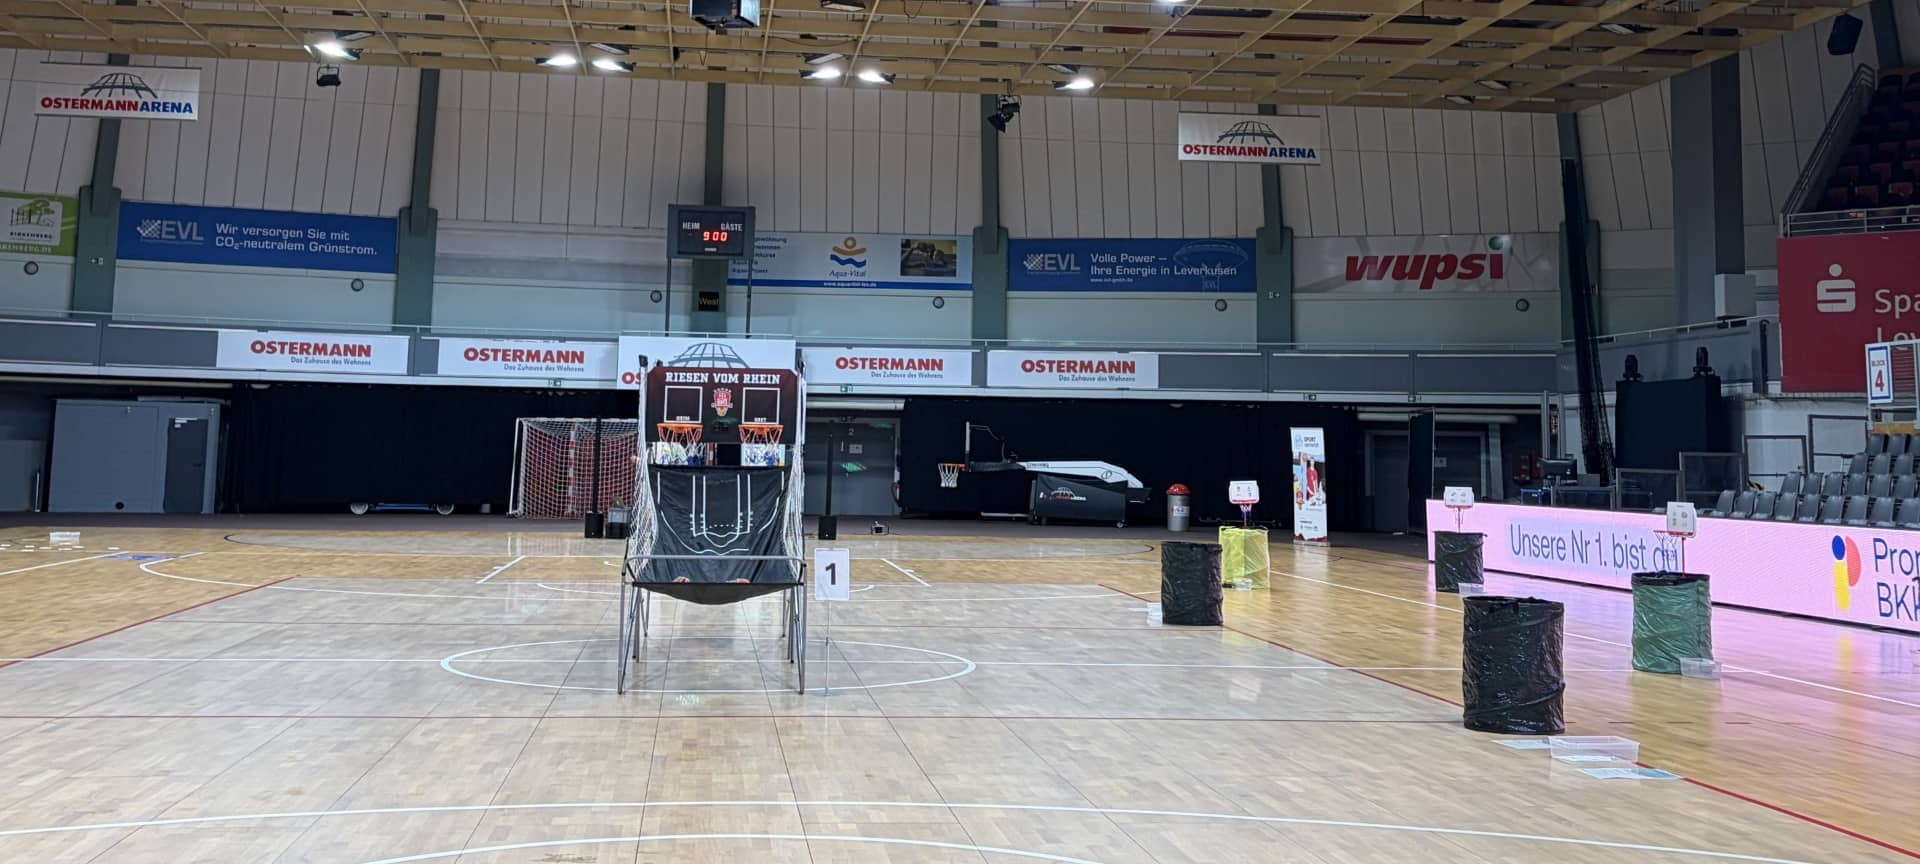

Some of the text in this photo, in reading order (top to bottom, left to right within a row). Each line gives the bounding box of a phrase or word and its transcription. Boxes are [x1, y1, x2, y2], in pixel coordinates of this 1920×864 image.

[41, 97, 193, 114] OSTERMANNARENA
[1183, 144, 1316, 159] OSTERMANNARENA
[161, 220, 204, 241] EVL
[216, 223, 350, 241] Wir versorgen Sie mit
[682, 222, 700, 230] HEIM
[309, 241, 378, 256] Grünstrom.
[1043, 253, 1080, 271] EVL
[1090, 254, 1117, 264] Volle
[1120, 254, 1155, 264] Power
[1345, 236, 1504, 290] wupsi
[1090, 265, 1237, 277] Ihre Energie in Leverkusen
[250, 340, 371, 358] OSTERMANN
[464, 347, 584, 364] OSTERMANN
[835, 357, 944, 371] OSTERMANN
[1021, 359, 1136, 374] OSTERMANN
[665, 372, 781, 384] RIESEN VOM RHEIN
[1875, 369, 1885, 392] 4
[1510, 523, 1566, 561] Unsere
[1571, 530, 1591, 564] Nr
[1612, 533, 1646, 570] bist
[825, 562, 837, 585] 1
